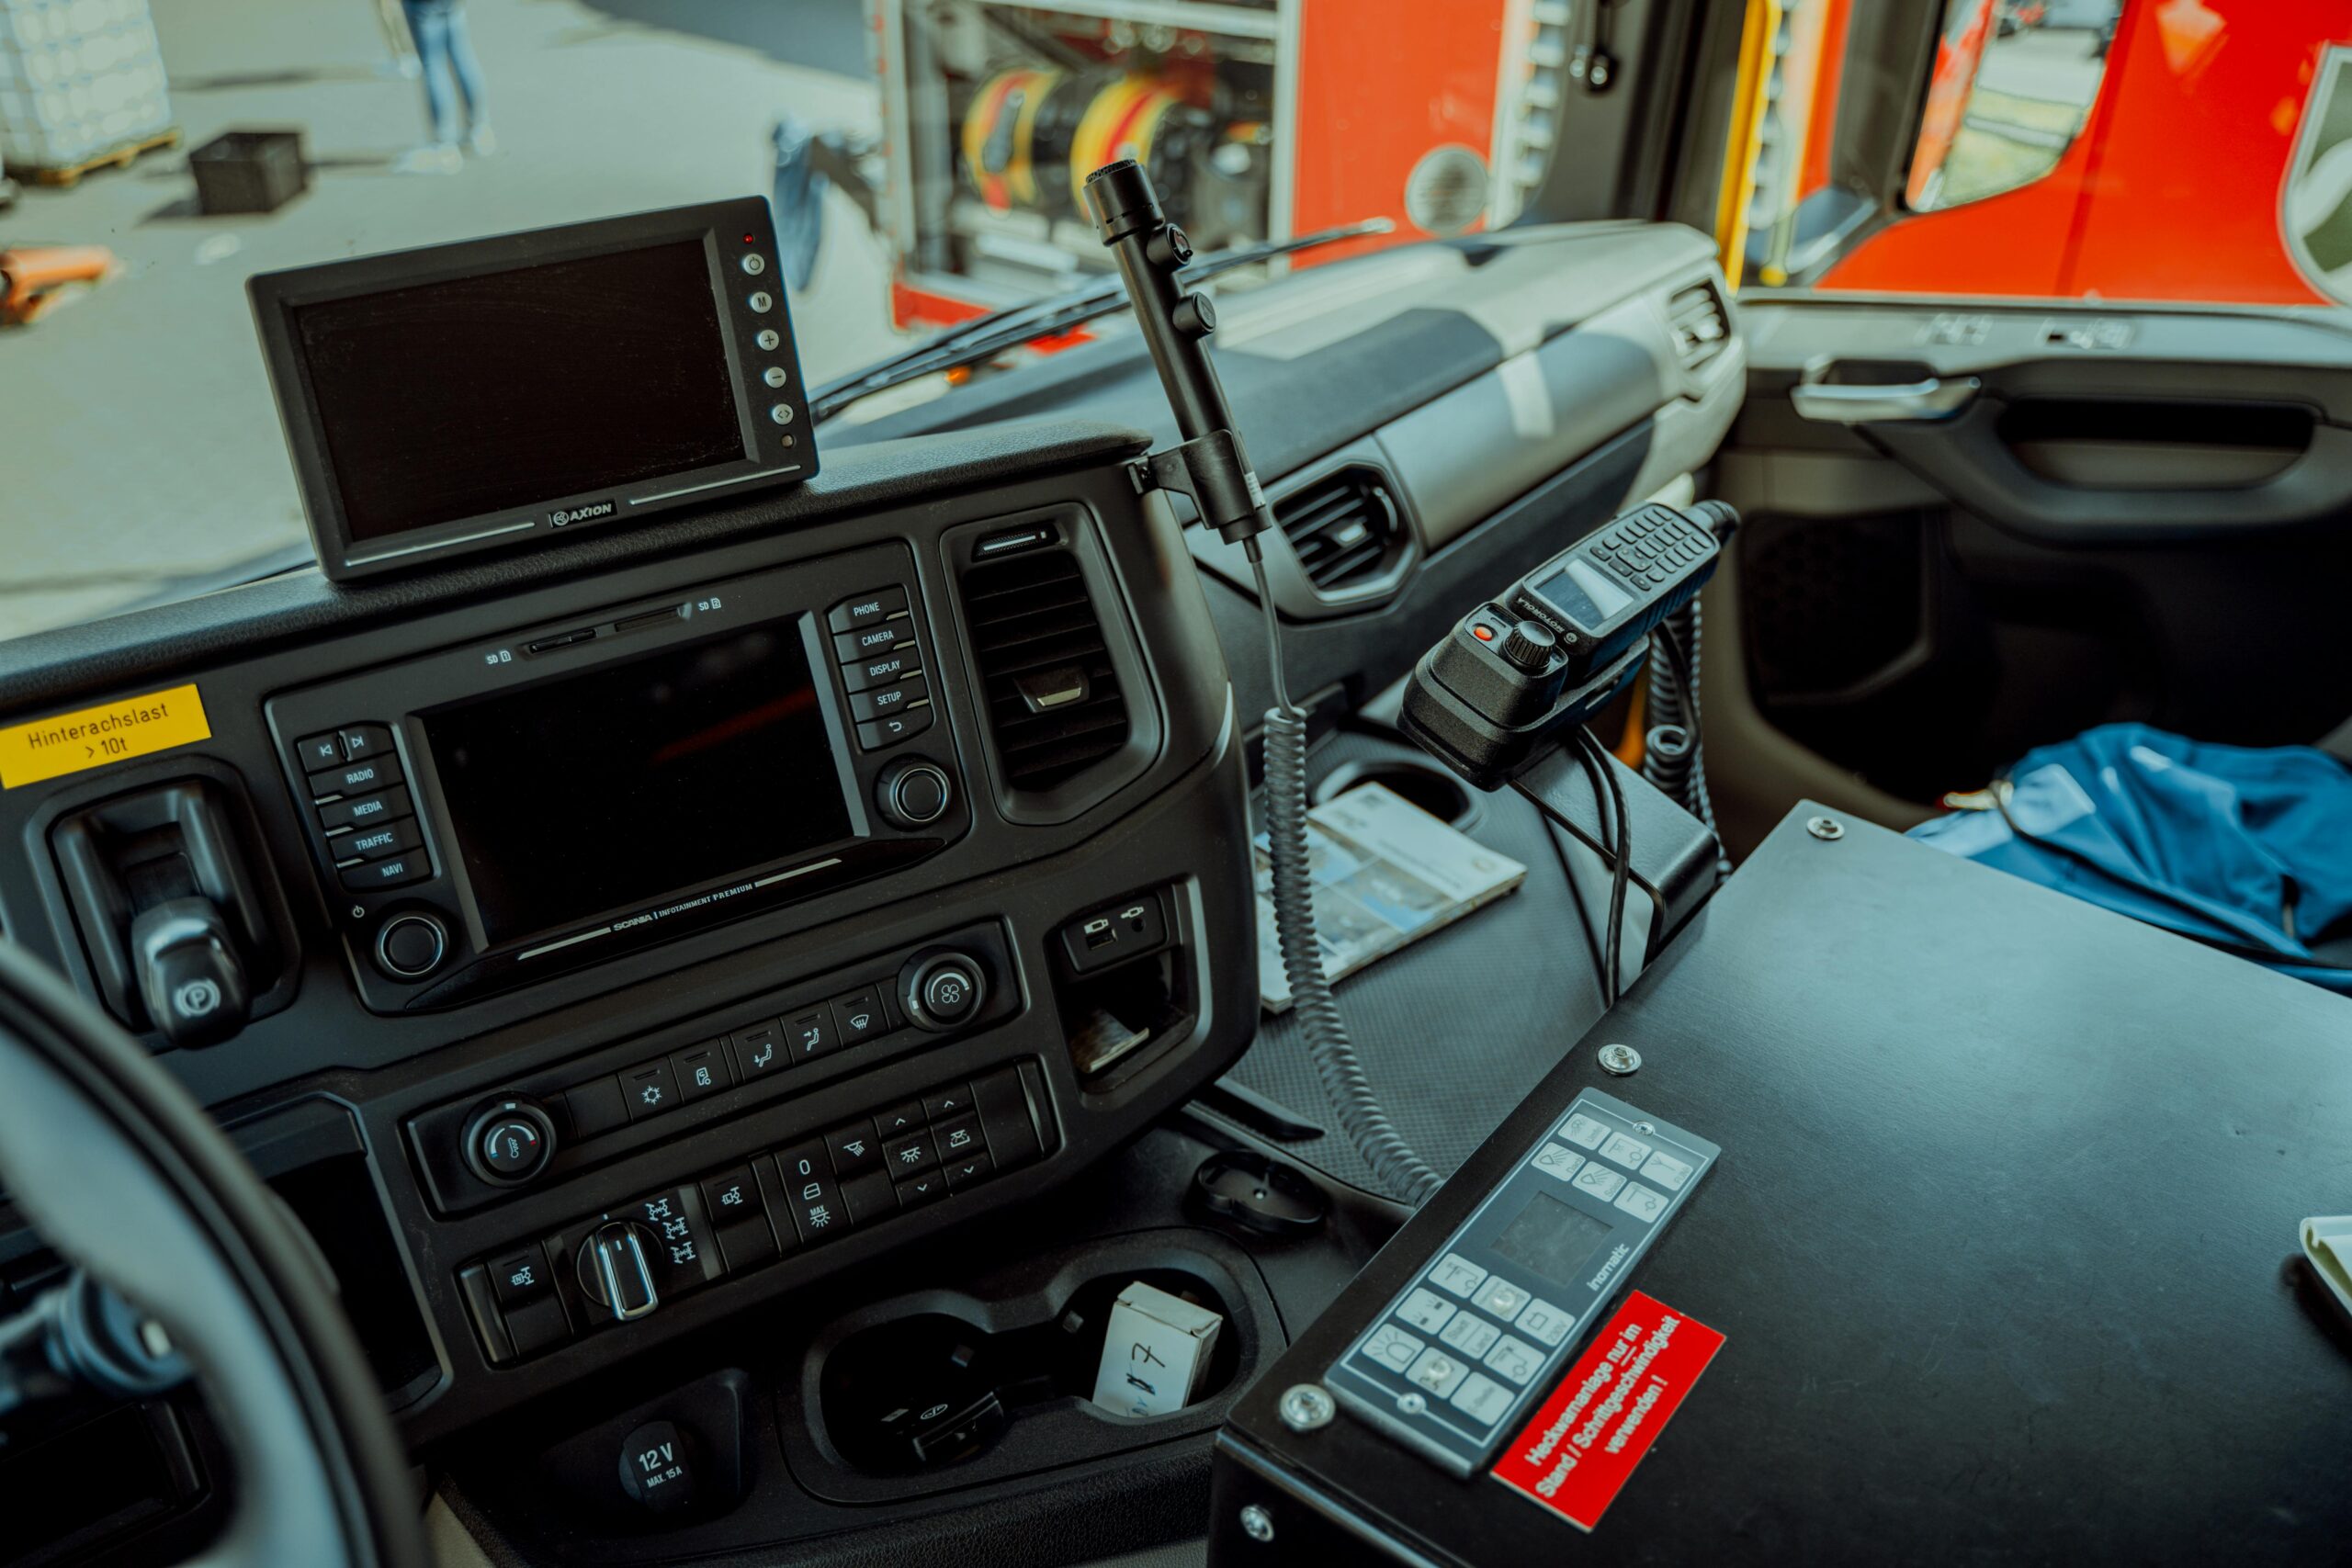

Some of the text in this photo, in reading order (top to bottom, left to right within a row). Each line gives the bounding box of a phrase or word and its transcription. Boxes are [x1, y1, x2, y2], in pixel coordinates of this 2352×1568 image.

[570, 503, 612, 521] AXION
[853, 602, 880, 616] PHONE
[1518, 597, 1565, 634] MOTOROLA
[862, 630, 894, 647] CAMERA
[869, 660, 900, 677] DISPLAY
[876, 691, 901, 705] SETUP
[28, 703, 169, 750] Hinterachslast
[101, 737, 128, 756] 10t
[345, 768, 374, 784] RADIO
[353, 801, 383, 817] MEDIA
[356, 832, 394, 851] TRAFFIC
[382, 863, 403, 877] NAVI
[613, 884, 753, 931] SCANIA INFOTAINMENT PREMIUM
[809, 1204, 826, 1217] MAX
[1524, 1323, 1643, 1466] Heckwarnanlage nur im
[1535, 1452, 1577, 1498] Stand
[1572, 1314, 1680, 1449] Schrittgeschwindigkeit
[1604, 1385, 1663, 1454] verwenden
[639, 1442, 673, 1472] 12 V
[647, 1473, 667, 1488] MAX.
